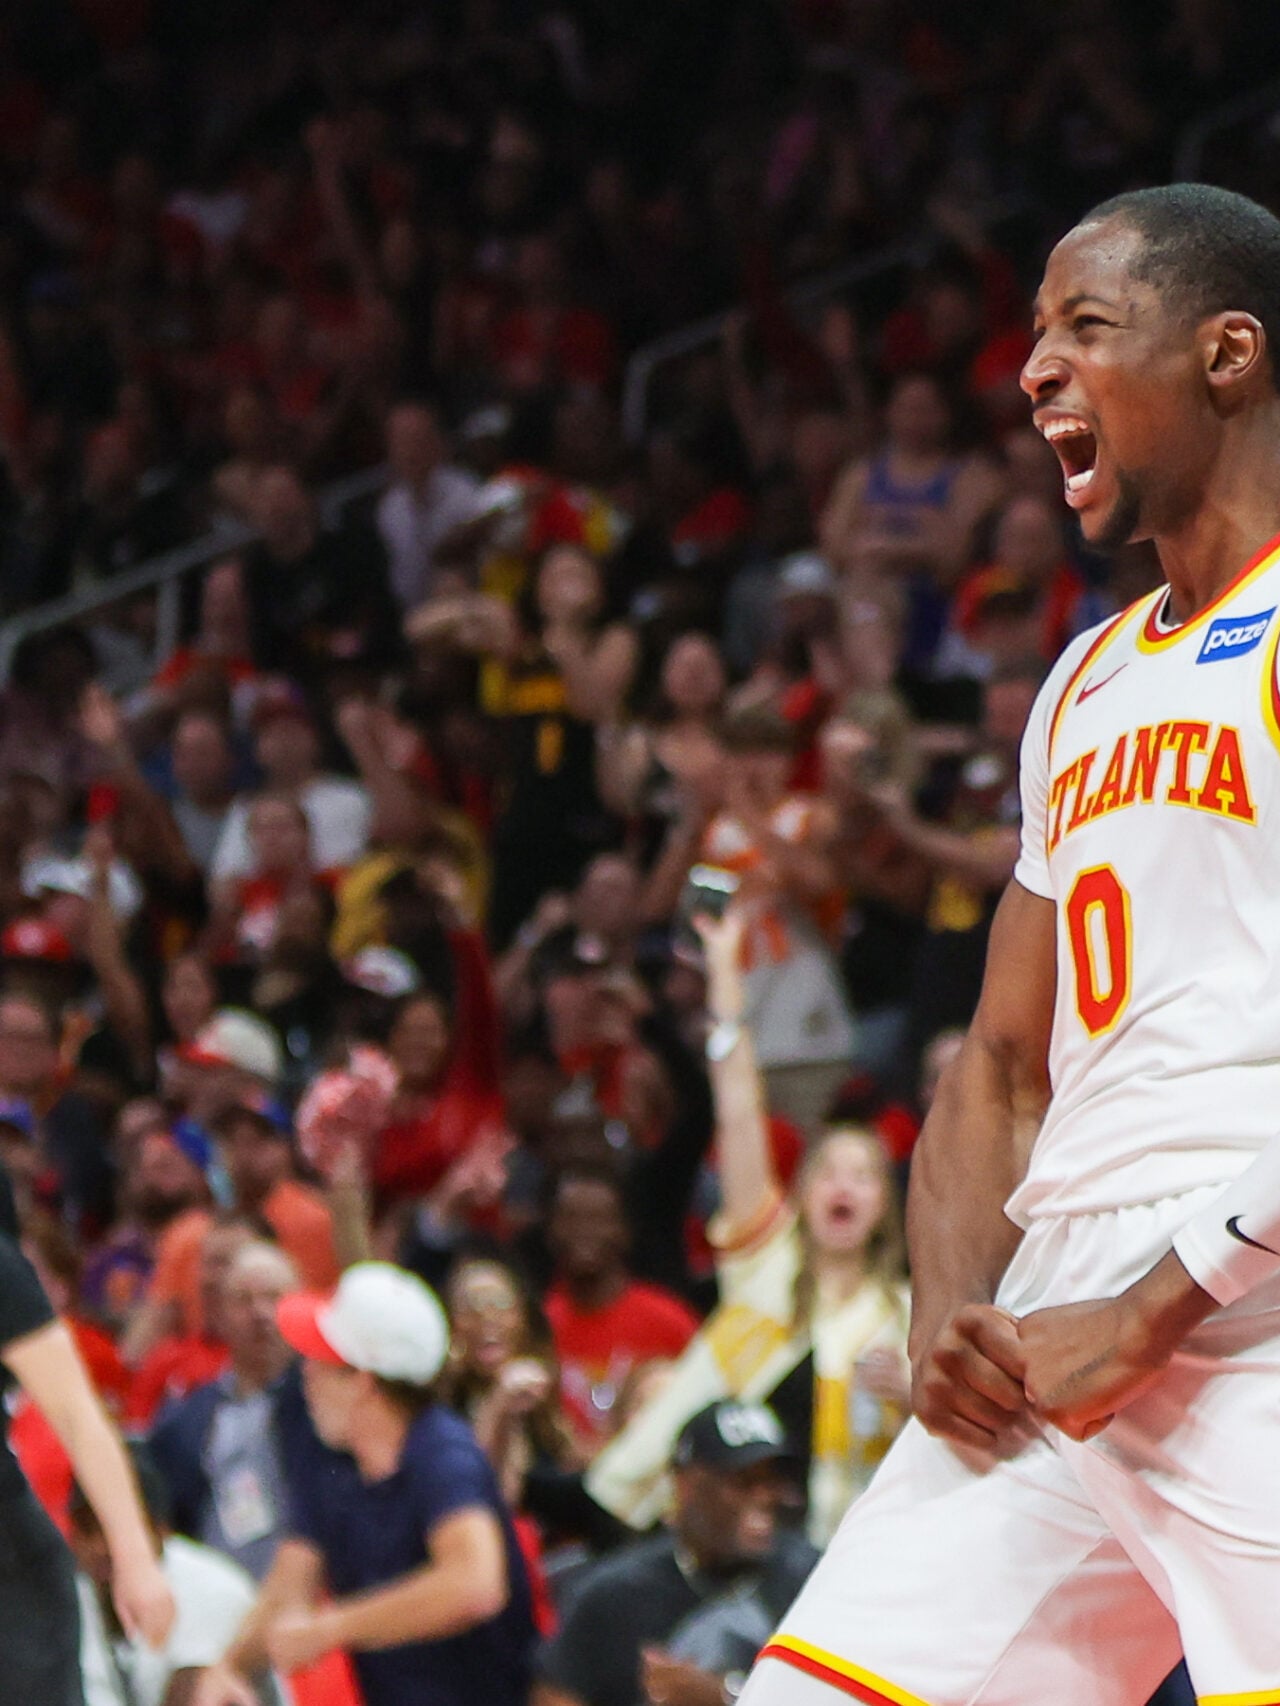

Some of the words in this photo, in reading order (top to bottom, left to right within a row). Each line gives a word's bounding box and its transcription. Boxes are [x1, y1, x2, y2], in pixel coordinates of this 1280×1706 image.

[1203, 619, 1269, 655] paze
[1046, 718, 1258, 856] TLANTA
[1066, 862, 1133, 1040] 0
